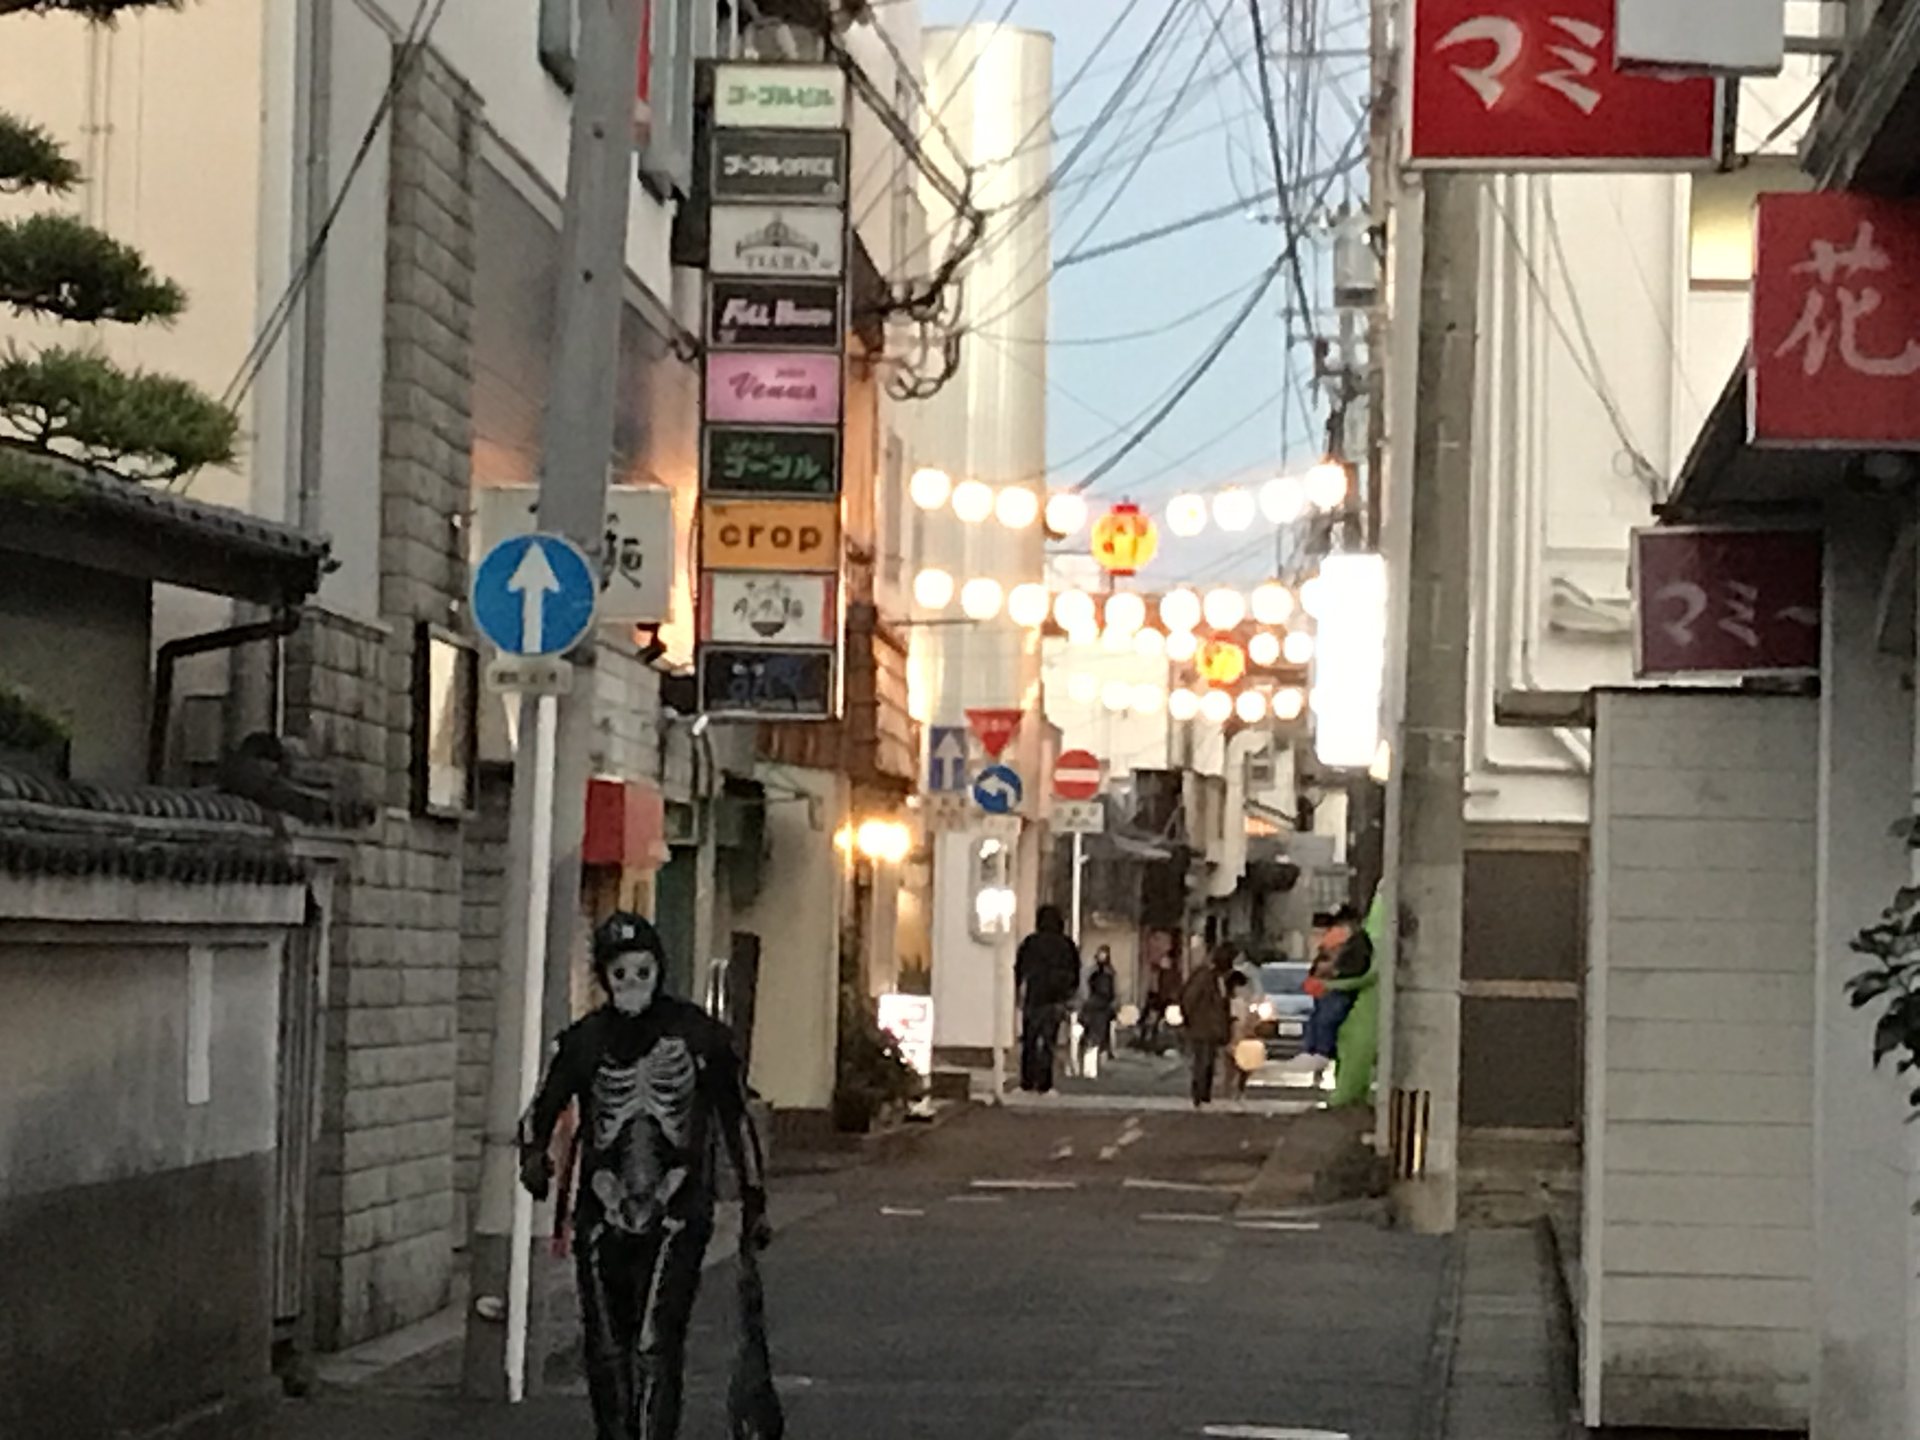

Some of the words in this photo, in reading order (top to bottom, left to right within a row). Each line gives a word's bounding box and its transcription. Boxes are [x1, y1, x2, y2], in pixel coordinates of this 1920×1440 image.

[1774, 220, 1920, 377] 花
[729, 371, 817, 400] Venus
[719, 523, 822, 553] crop
